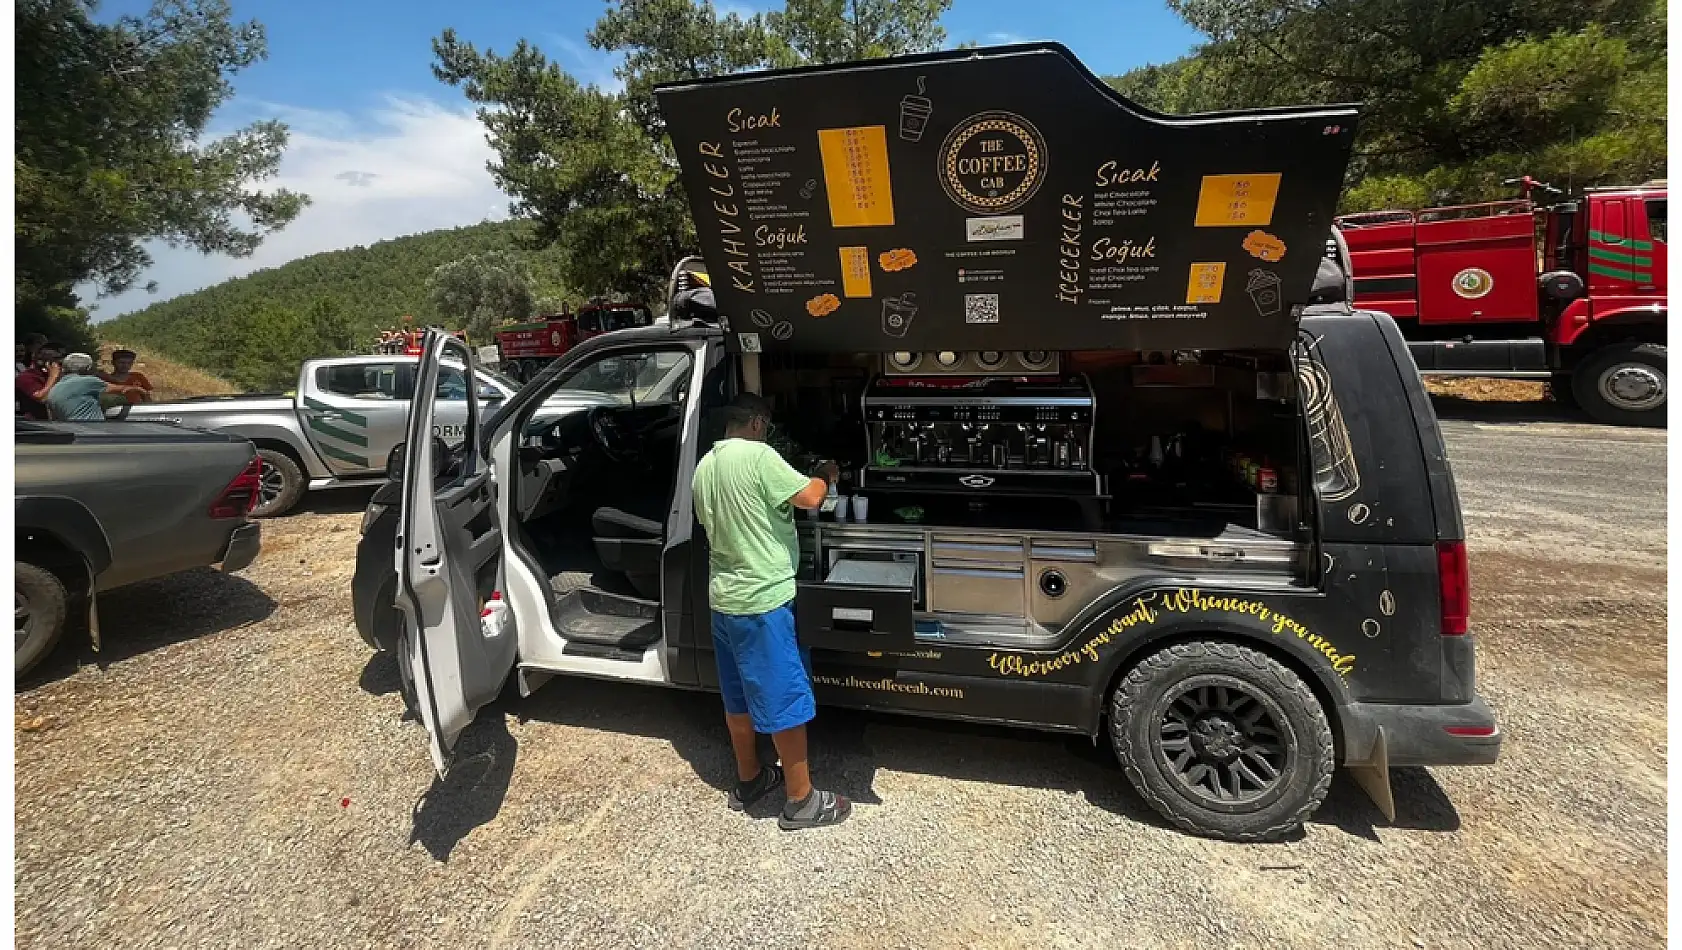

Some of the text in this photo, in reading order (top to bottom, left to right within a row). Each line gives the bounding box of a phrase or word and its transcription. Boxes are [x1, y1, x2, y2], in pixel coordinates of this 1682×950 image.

[727, 107, 781, 133] Sıcak
[980, 139, 1003, 152] THE
[959, 154, 1025, 175] COFFEE
[1096, 160, 1161, 187] Sıcak
[981, 177, 1004, 188] CAB
[699, 141, 756, 294] KAHVELER
[754, 224, 808, 249] Soğuk
[1055, 193, 1083, 304] İÇECEKLER
[1090, 236, 1156, 264] Soğuk
[812, 675, 965, 699] www.thecoffeecab.com
